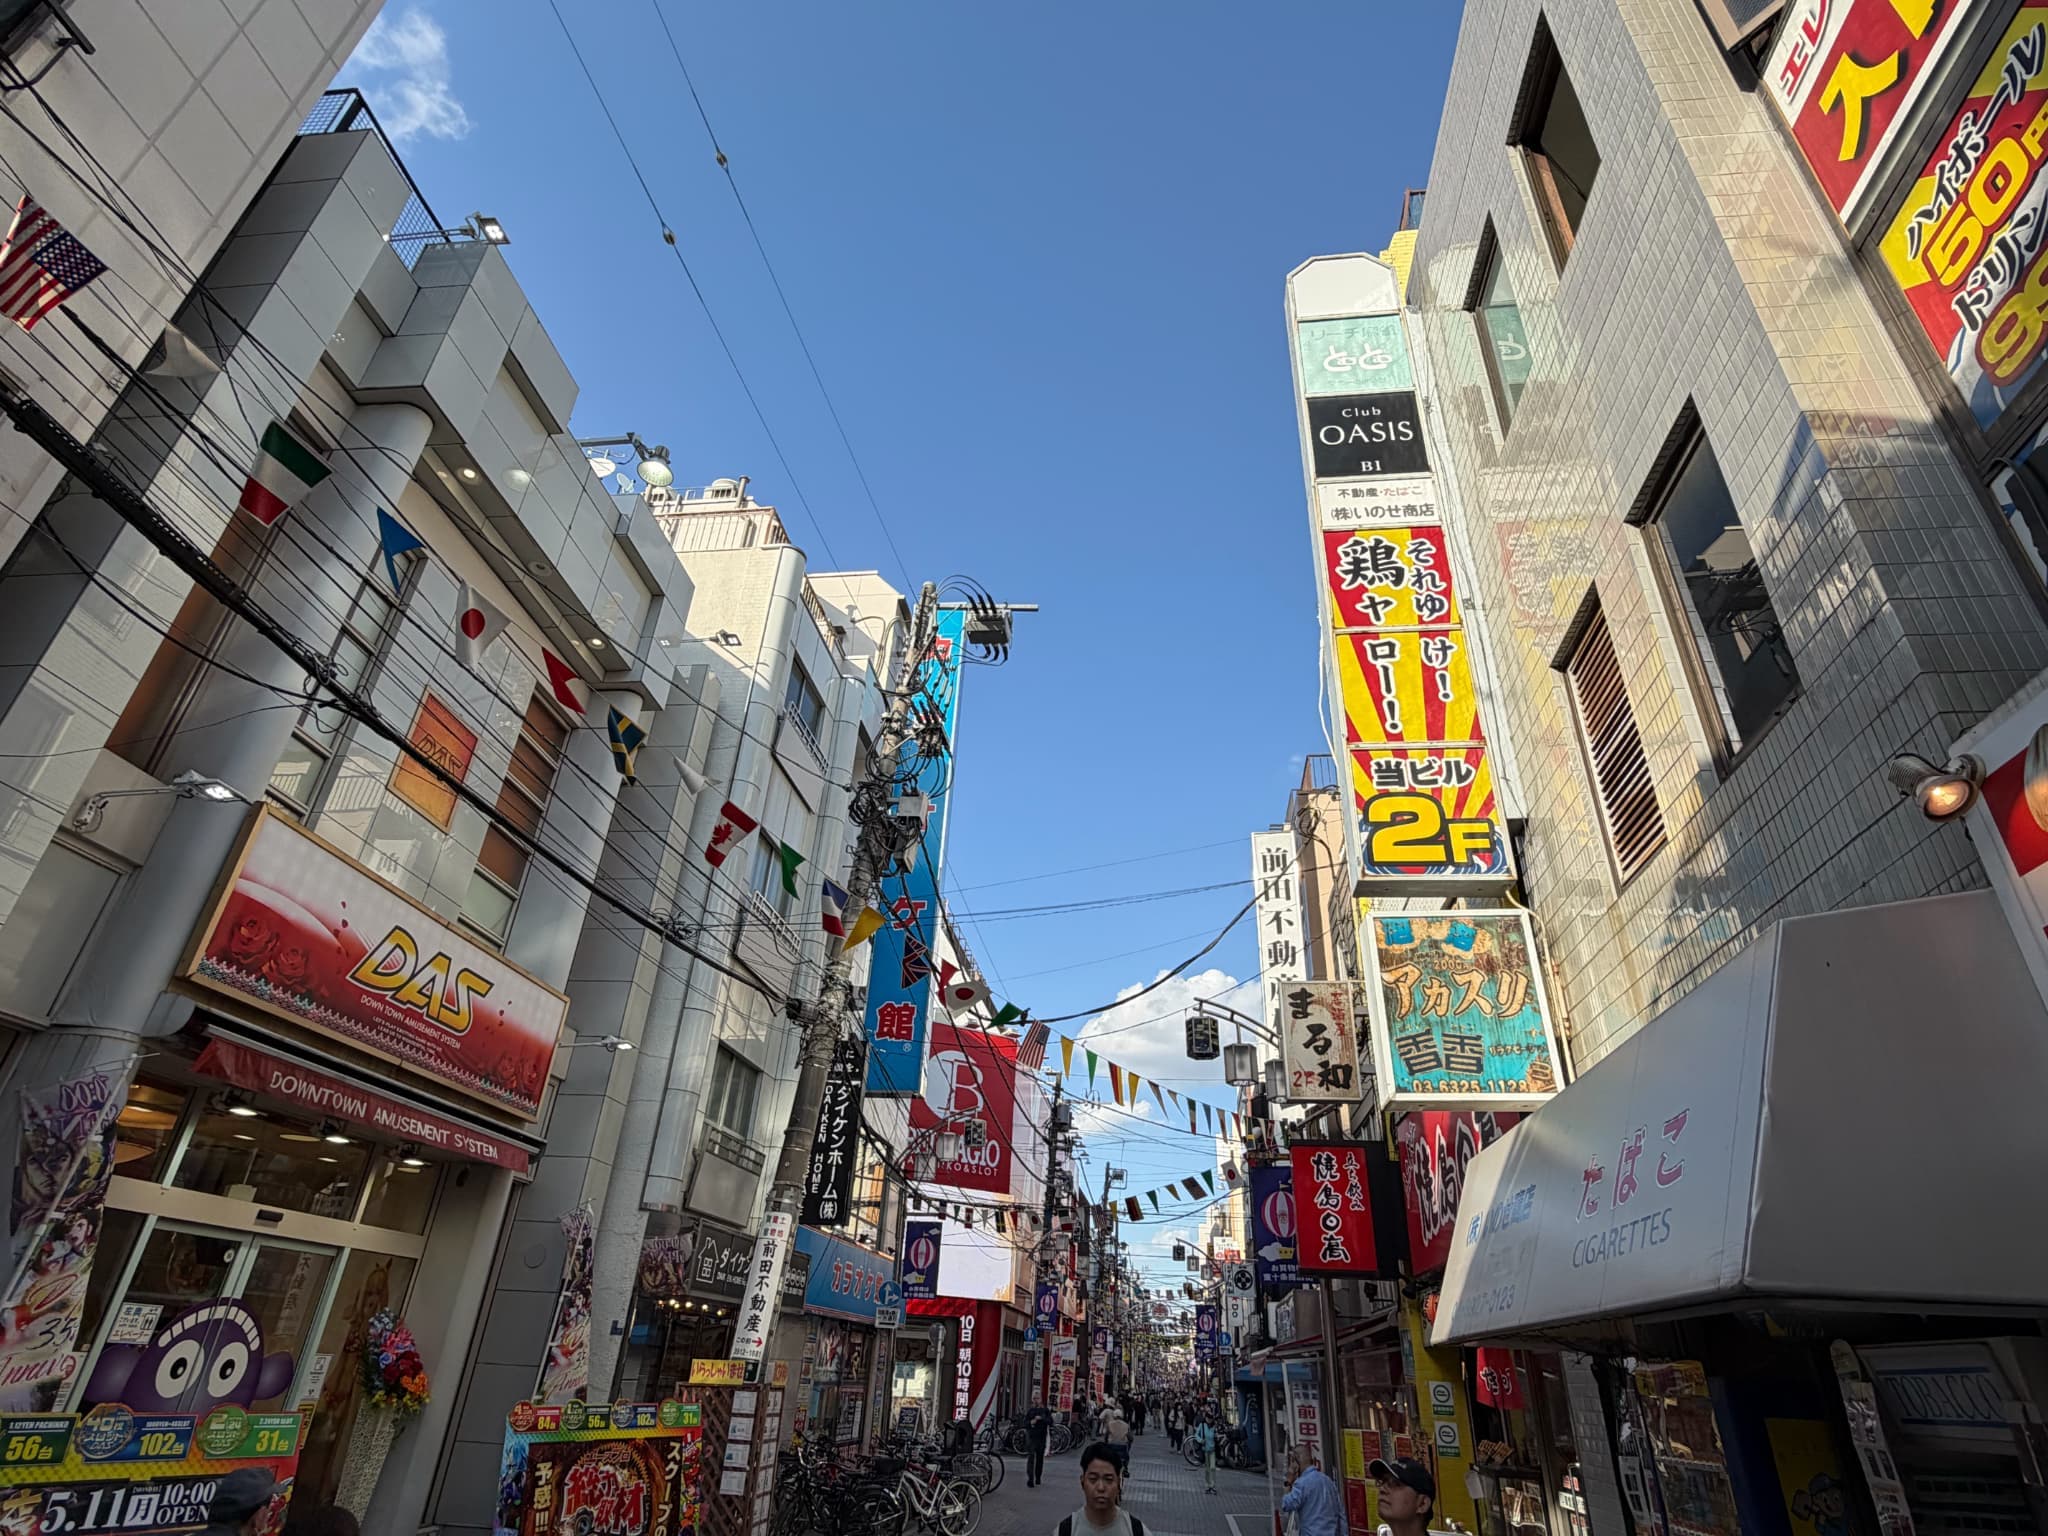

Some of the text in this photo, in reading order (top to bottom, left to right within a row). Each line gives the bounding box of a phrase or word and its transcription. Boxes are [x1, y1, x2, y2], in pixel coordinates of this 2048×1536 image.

[1906, 20, 2046, 262] ハイボール
[1319, 421, 1414, 445] OASIS
[1342, 407, 1382, 418] Club
[1361, 460, 1382, 472] B1
[1331, 503, 1436, 521] (株)いのせ商店
[415, 733, 464, 776] DAS
[1373, 758, 1474, 789] 当ビル
[1365, 791, 1495, 867] 2F
[346, 925, 496, 1035] DAS
[1380, 962, 1530, 1019] アカスリ
[361, 995, 462, 1049] DOWN TOWN AMUSEMENT SYSTEM
[1287, 987, 1352, 1091] まる和
[1292, 1070, 1316, 1088] 2F
[1395, 1028, 1484, 1076] 香香
[270, 1071, 498, 1160] DOWNTOWN AMUSEMENT SYSTEM
[811, 1085, 833, 1194] DAIKEN HOME
[1343, 1152, 1365, 1211] 立ち飲み
[1577, 1109, 1690, 1223] たばこ
[1572, 1208, 1673, 1269] CIGARETTES
[744, 1239, 779, 1334] 前田不動産
[954, 1314, 975, 1421] 10日 朝10時開店
[1887, 1374, 2005, 1420] TOBACCO
[40, 1488, 128, 1534] 5.11
[124, 1494, 160, 1527] 月
[156, 1505, 211, 1525] OPEN
[160, 1481, 217, 1506] 10:00
[533, 1462, 553, 1532] 予感!!!
